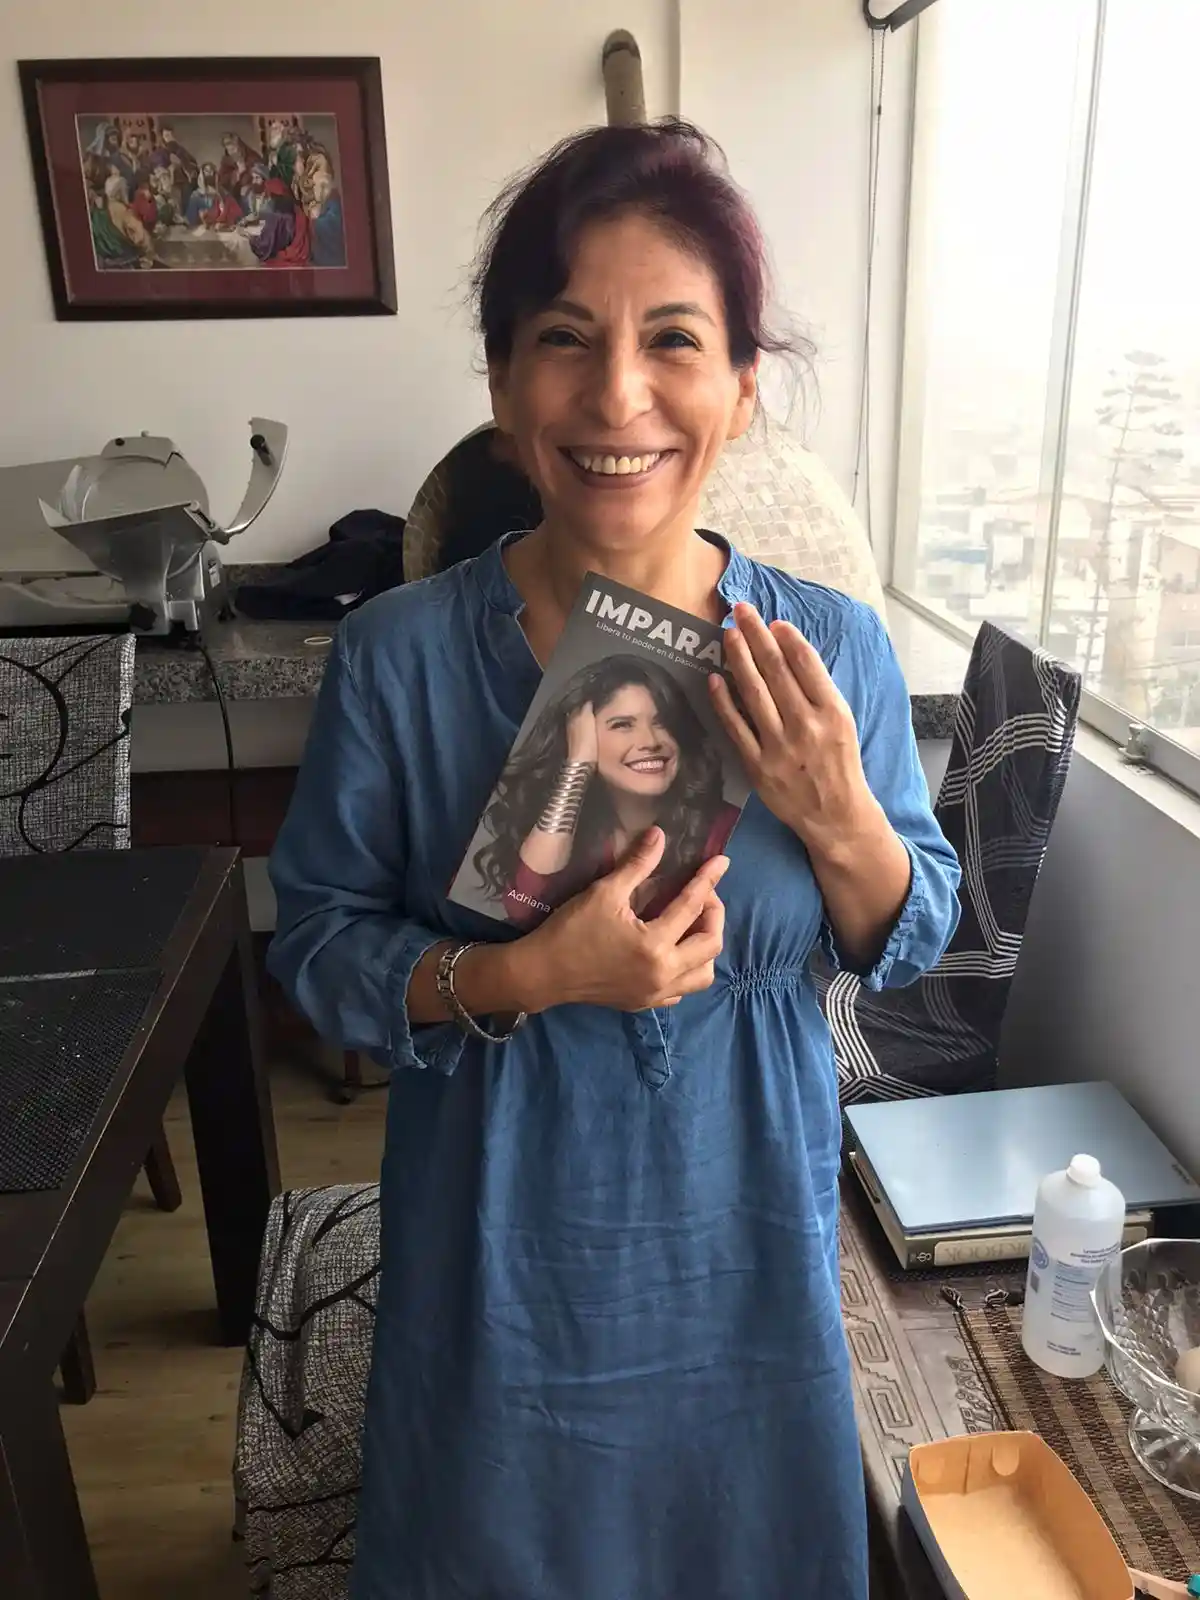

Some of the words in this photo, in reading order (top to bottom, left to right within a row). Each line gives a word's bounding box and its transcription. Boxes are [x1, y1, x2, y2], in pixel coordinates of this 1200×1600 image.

[585, 589, 731, 671] IMPARA
[596, 620, 621, 637] Libera
[622, 632, 632, 641] tu
[632, 637, 656, 651] poder
[657, 648, 668, 657] en
[507, 889, 551, 913] Adriana
